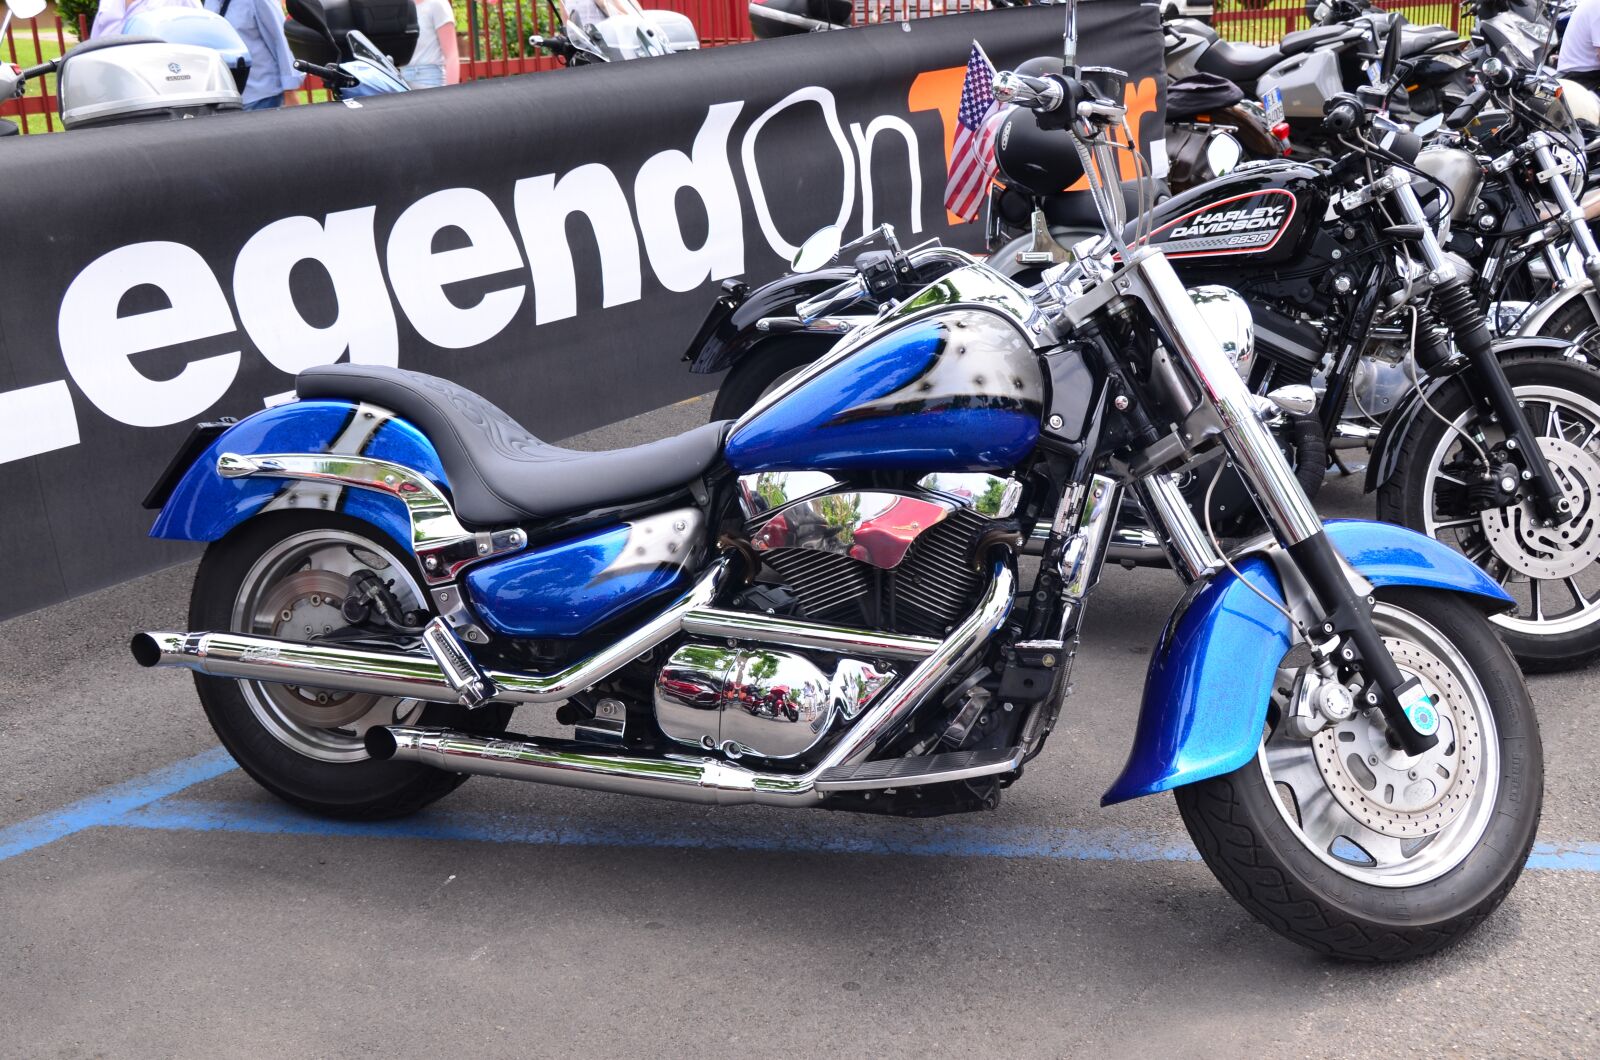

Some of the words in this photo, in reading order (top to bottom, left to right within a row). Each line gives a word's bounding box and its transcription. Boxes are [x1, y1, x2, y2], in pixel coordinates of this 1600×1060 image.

[1193, 205, 1285, 225] HARLEY-
[1170, 216, 1282, 238] DAVIDSON
[1228, 233, 1270, 245] 883R
